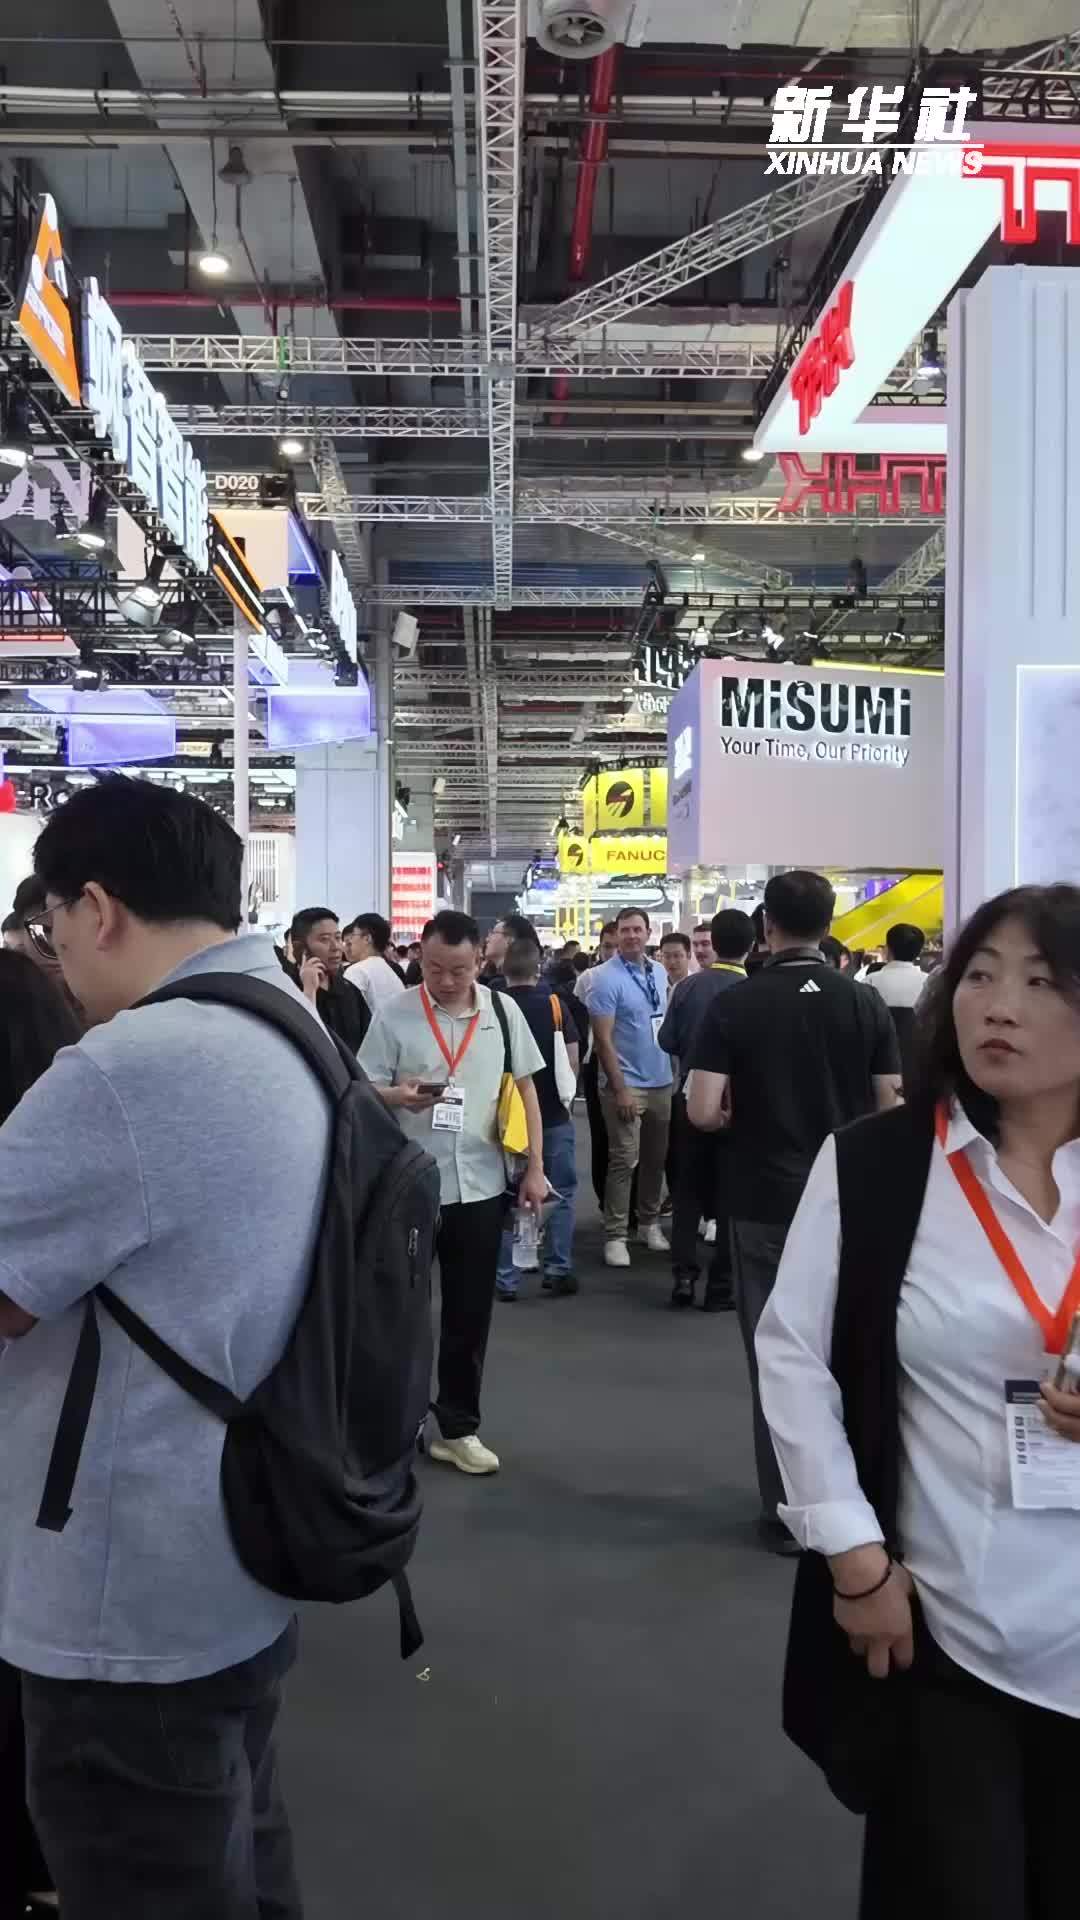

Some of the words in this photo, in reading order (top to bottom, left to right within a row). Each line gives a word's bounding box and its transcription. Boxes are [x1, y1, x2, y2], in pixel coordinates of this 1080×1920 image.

[721, 676, 911, 736] MiSUMi
[720, 736, 761, 755] Your
[765, 738, 810, 760] Time,
[815, 741, 846, 759] Our
[851, 743, 910, 767] Priority
[607, 850, 666, 861] FANUC
